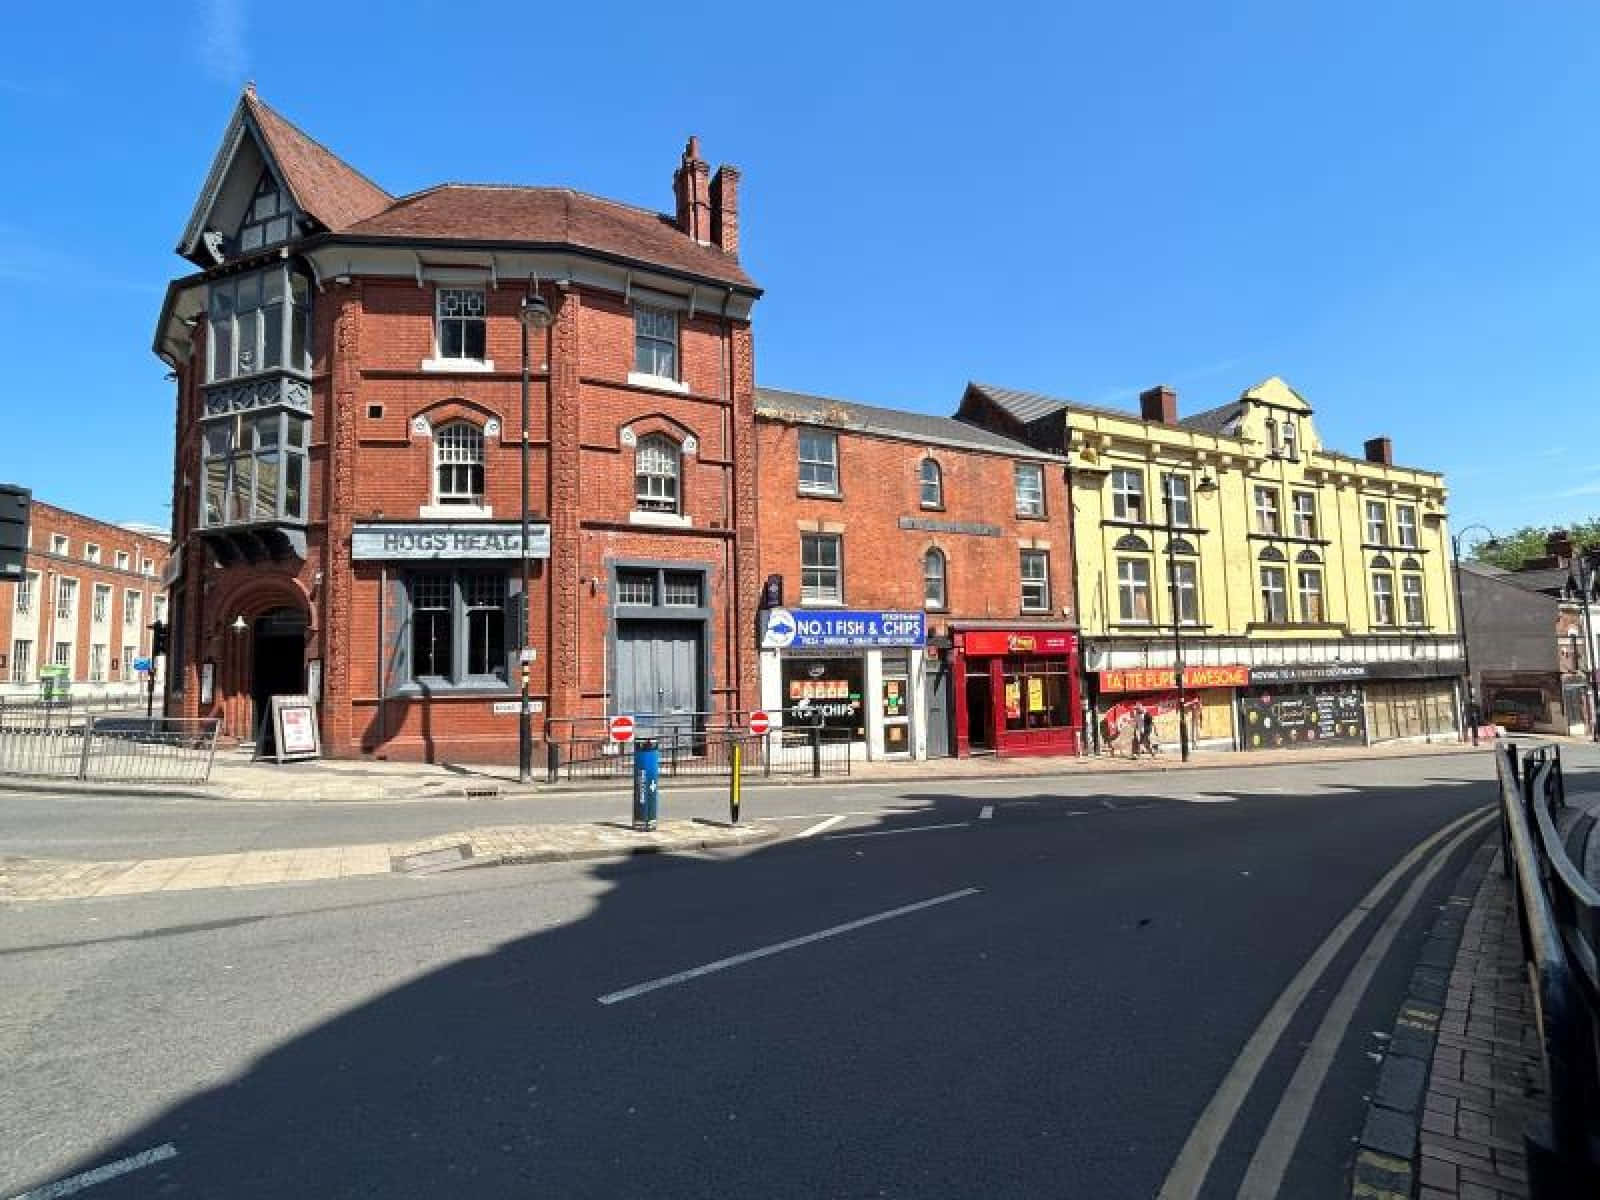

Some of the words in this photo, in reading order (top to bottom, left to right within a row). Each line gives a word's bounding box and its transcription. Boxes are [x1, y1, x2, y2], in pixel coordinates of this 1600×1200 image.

[797, 620, 833, 635] NO.1
[835, 620, 865, 635] FISH
[868, 621, 878, 635] &
[883, 620, 921, 637] CHIPS
